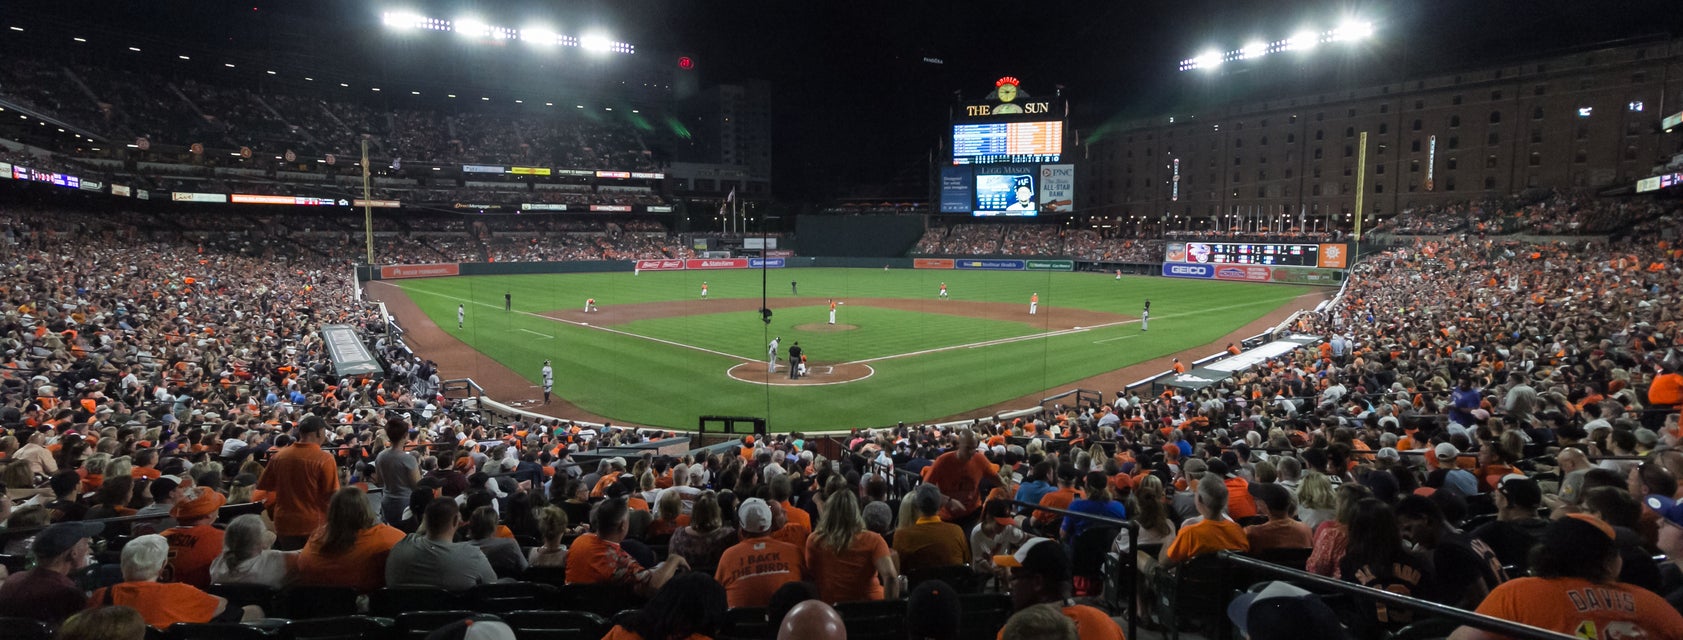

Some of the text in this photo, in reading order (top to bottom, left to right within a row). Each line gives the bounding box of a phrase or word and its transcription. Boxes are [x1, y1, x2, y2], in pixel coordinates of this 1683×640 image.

[995, 76, 1020, 88] ORIOLES
[966, 102, 1049, 116] THE SUN
[981, 166, 1032, 175] LEGG MASON
[1052, 168, 1073, 177] PNC
[1043, 183, 1071, 191] ALL-STAR
[1171, 265, 1207, 275] GEICO
[739, 552, 780, 567] I BACK
[732, 562, 789, 578] THE BIRDS
[1567, 587, 1637, 614] DAVIS
